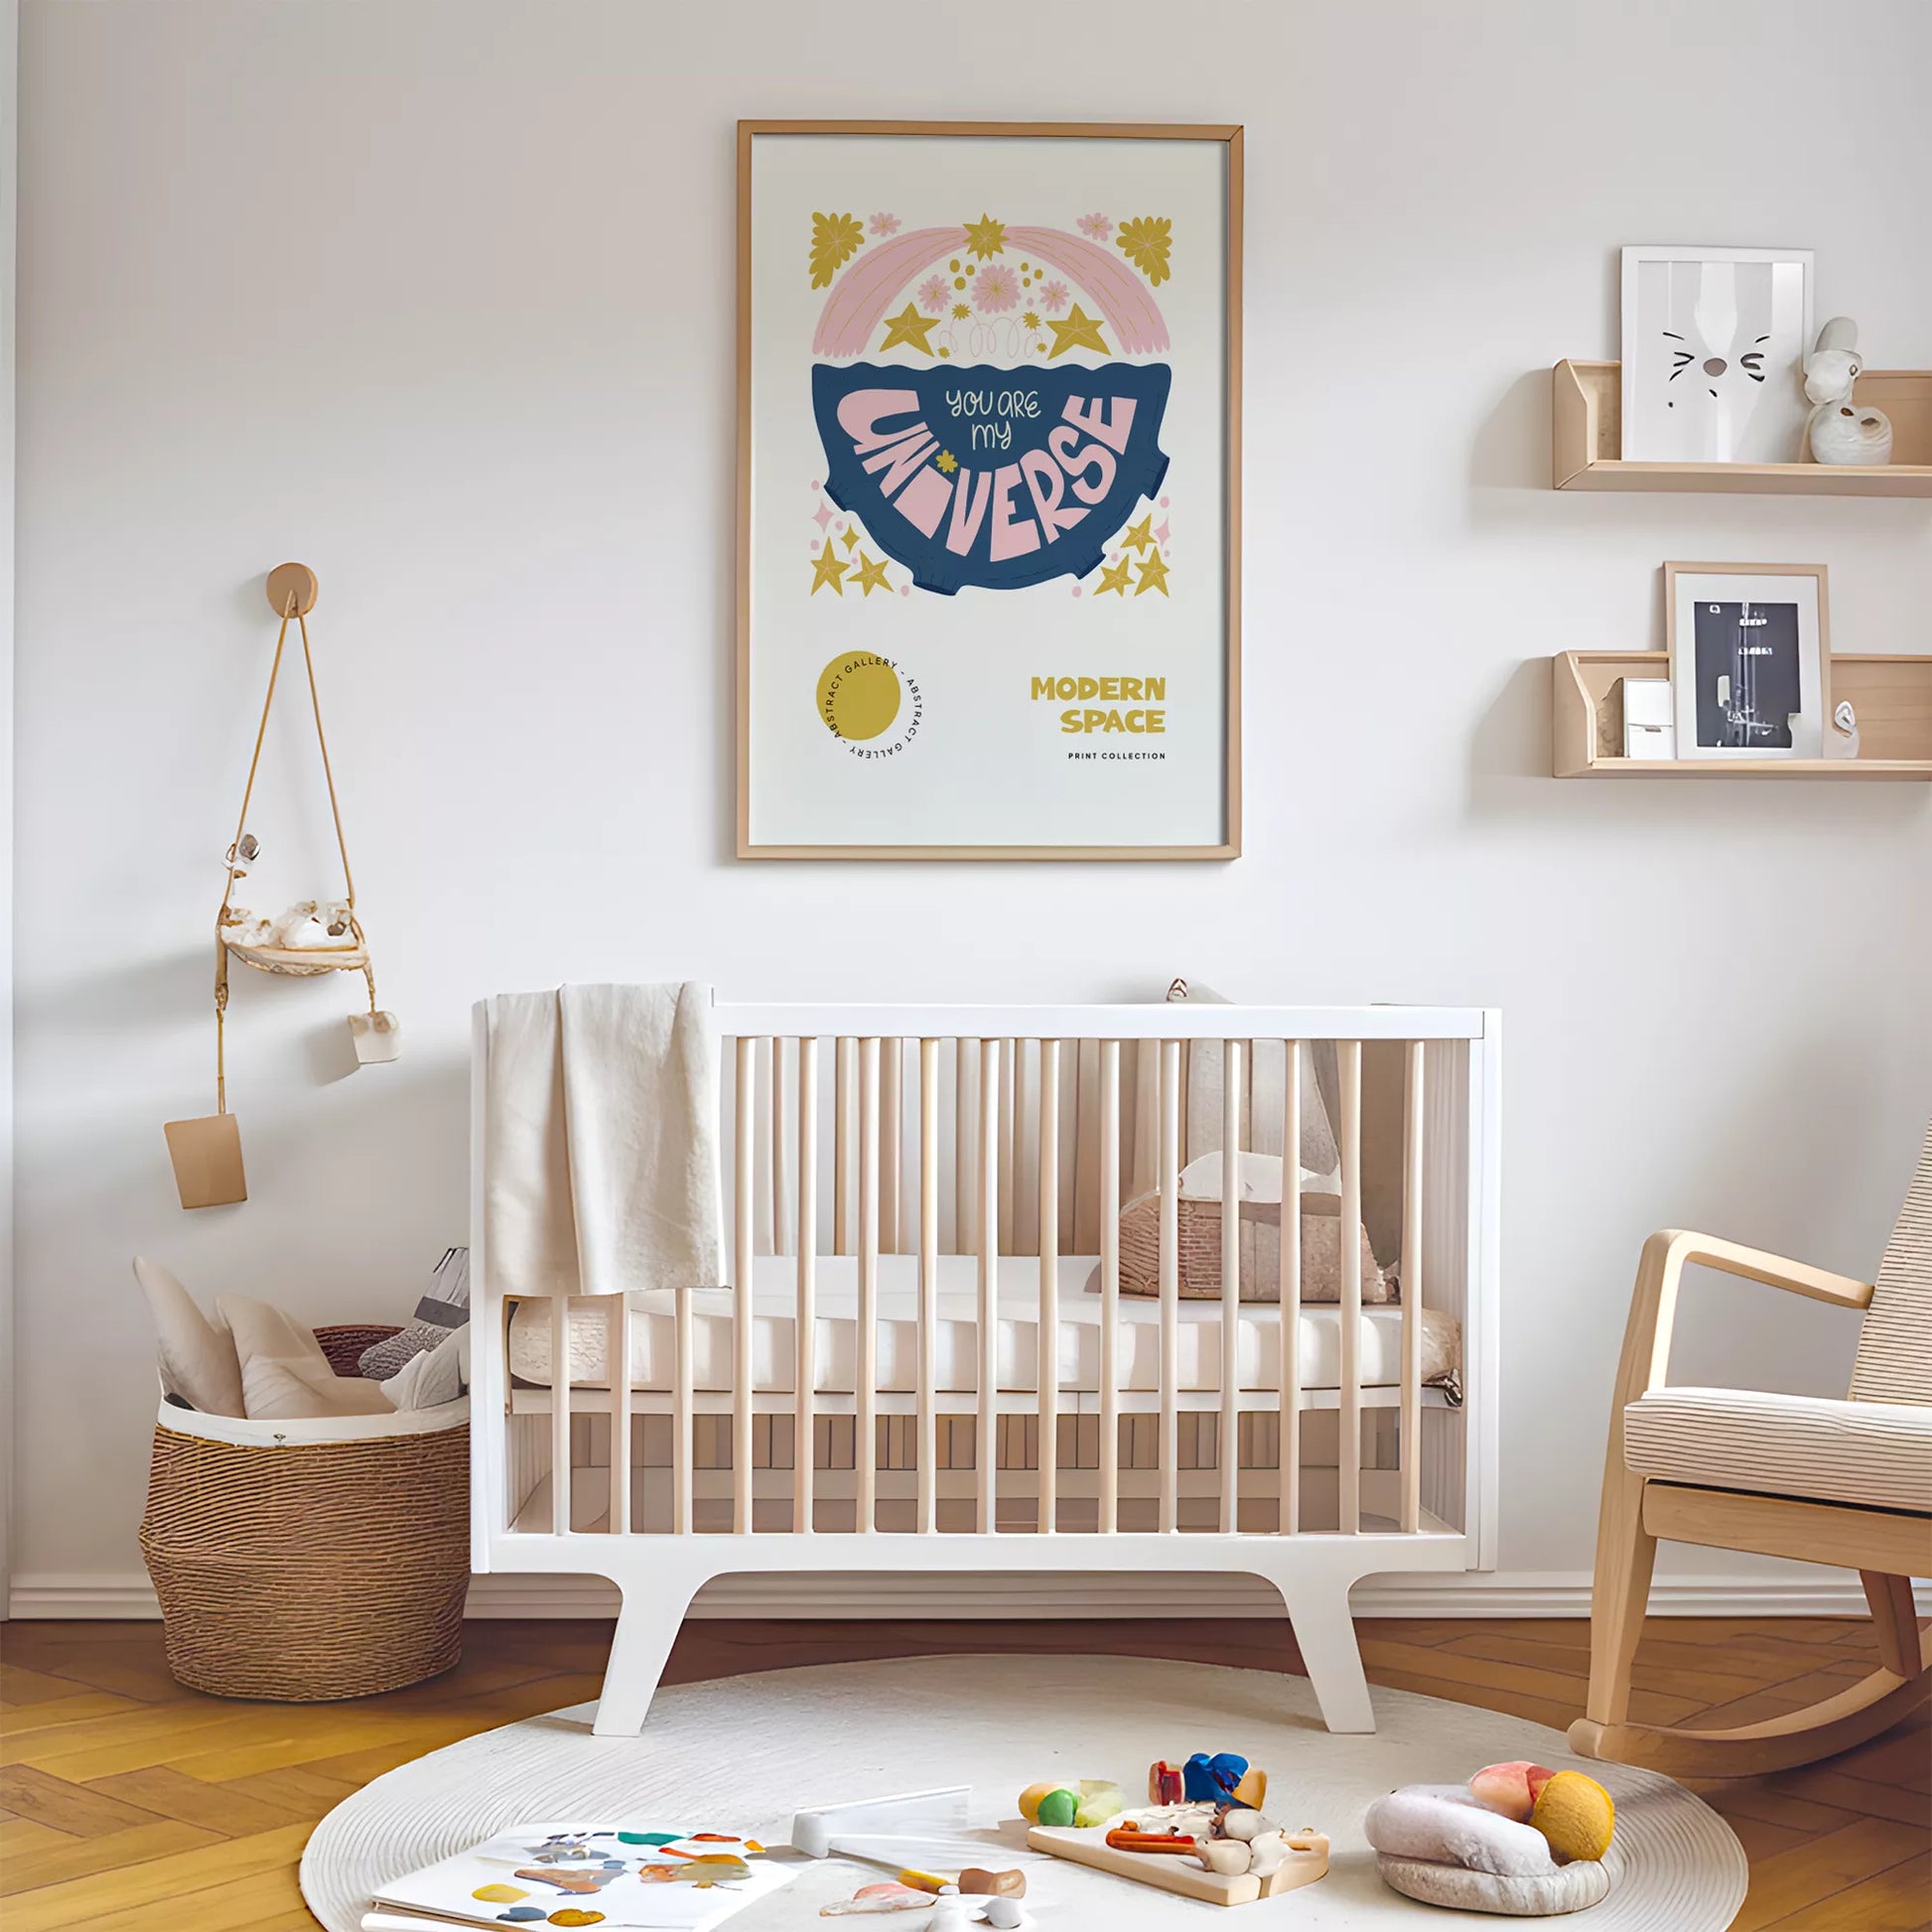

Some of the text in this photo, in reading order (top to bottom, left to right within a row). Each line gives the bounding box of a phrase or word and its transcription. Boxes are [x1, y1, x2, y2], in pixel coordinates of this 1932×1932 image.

[844, 656, 897, 674] GALLERY
[1031, 676, 1166, 701] MODERN
[825, 674, 843, 739] ABSTRACT
[904, 678, 922, 743] ABSTRACT
[1059, 709, 1166, 734] SPACE
[849, 743, 902, 759] GALLERY
